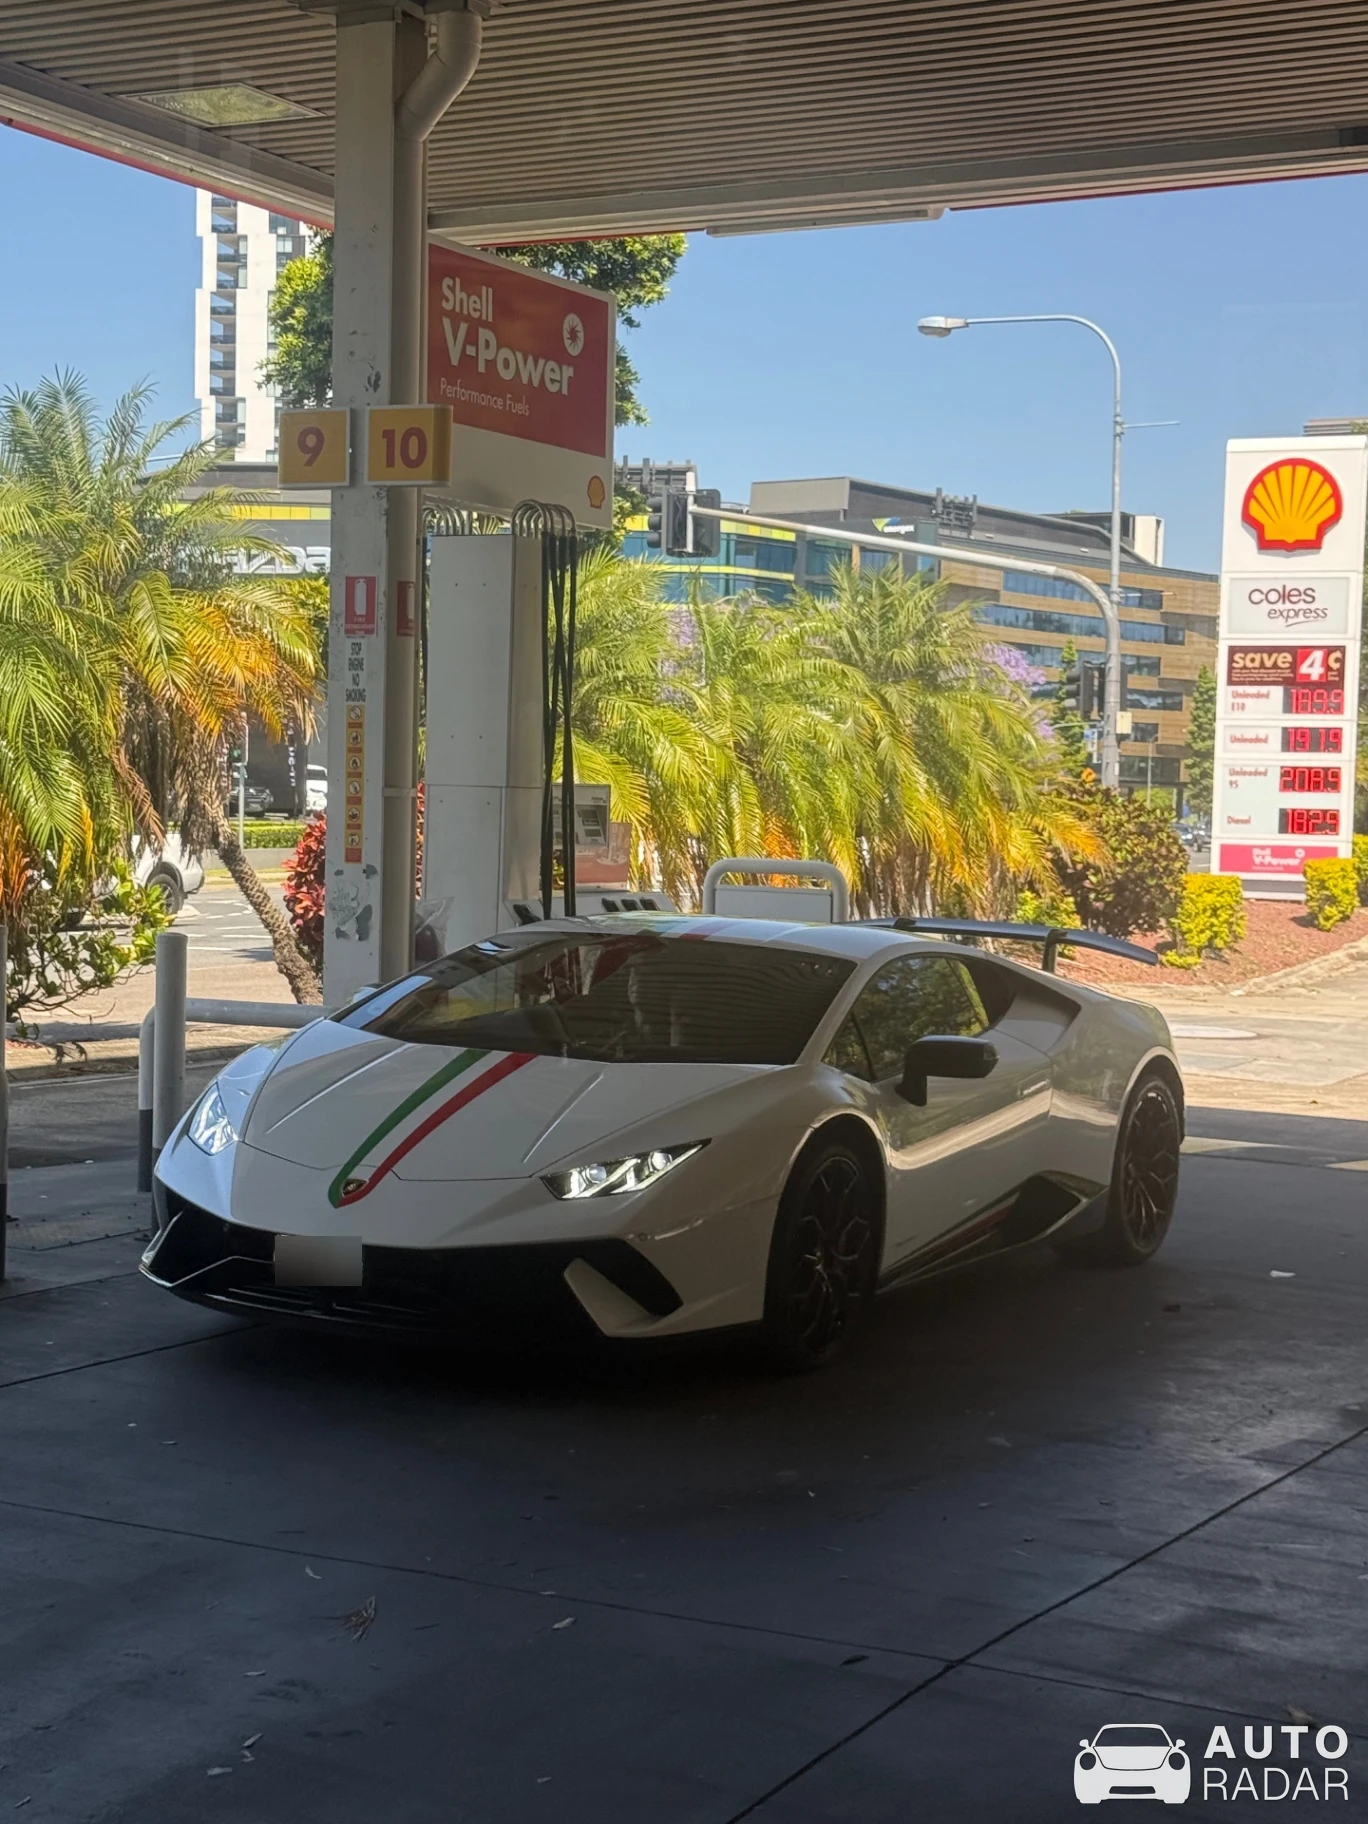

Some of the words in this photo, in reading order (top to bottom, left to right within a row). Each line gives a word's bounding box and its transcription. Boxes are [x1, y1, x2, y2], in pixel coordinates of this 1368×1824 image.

[442, 277, 493, 322] Shell
[442, 316, 574, 396] V-Power
[440, 377, 503, 410] Performance
[506, 394, 530, 416] Fuels
[297, 426, 325, 467] 9
[382, 427, 428, 469] 10
[1248, 585, 1316, 605] coles
[1267, 607, 1328, 623] express
[1231, 652, 1293, 668] save
[1231, 689, 1270, 699] Unleaded
[1229, 734, 1269, 744] Unleaded
[1229, 767, 1268, 777] Unleaded
[1227, 815, 1251, 825] Diesel
